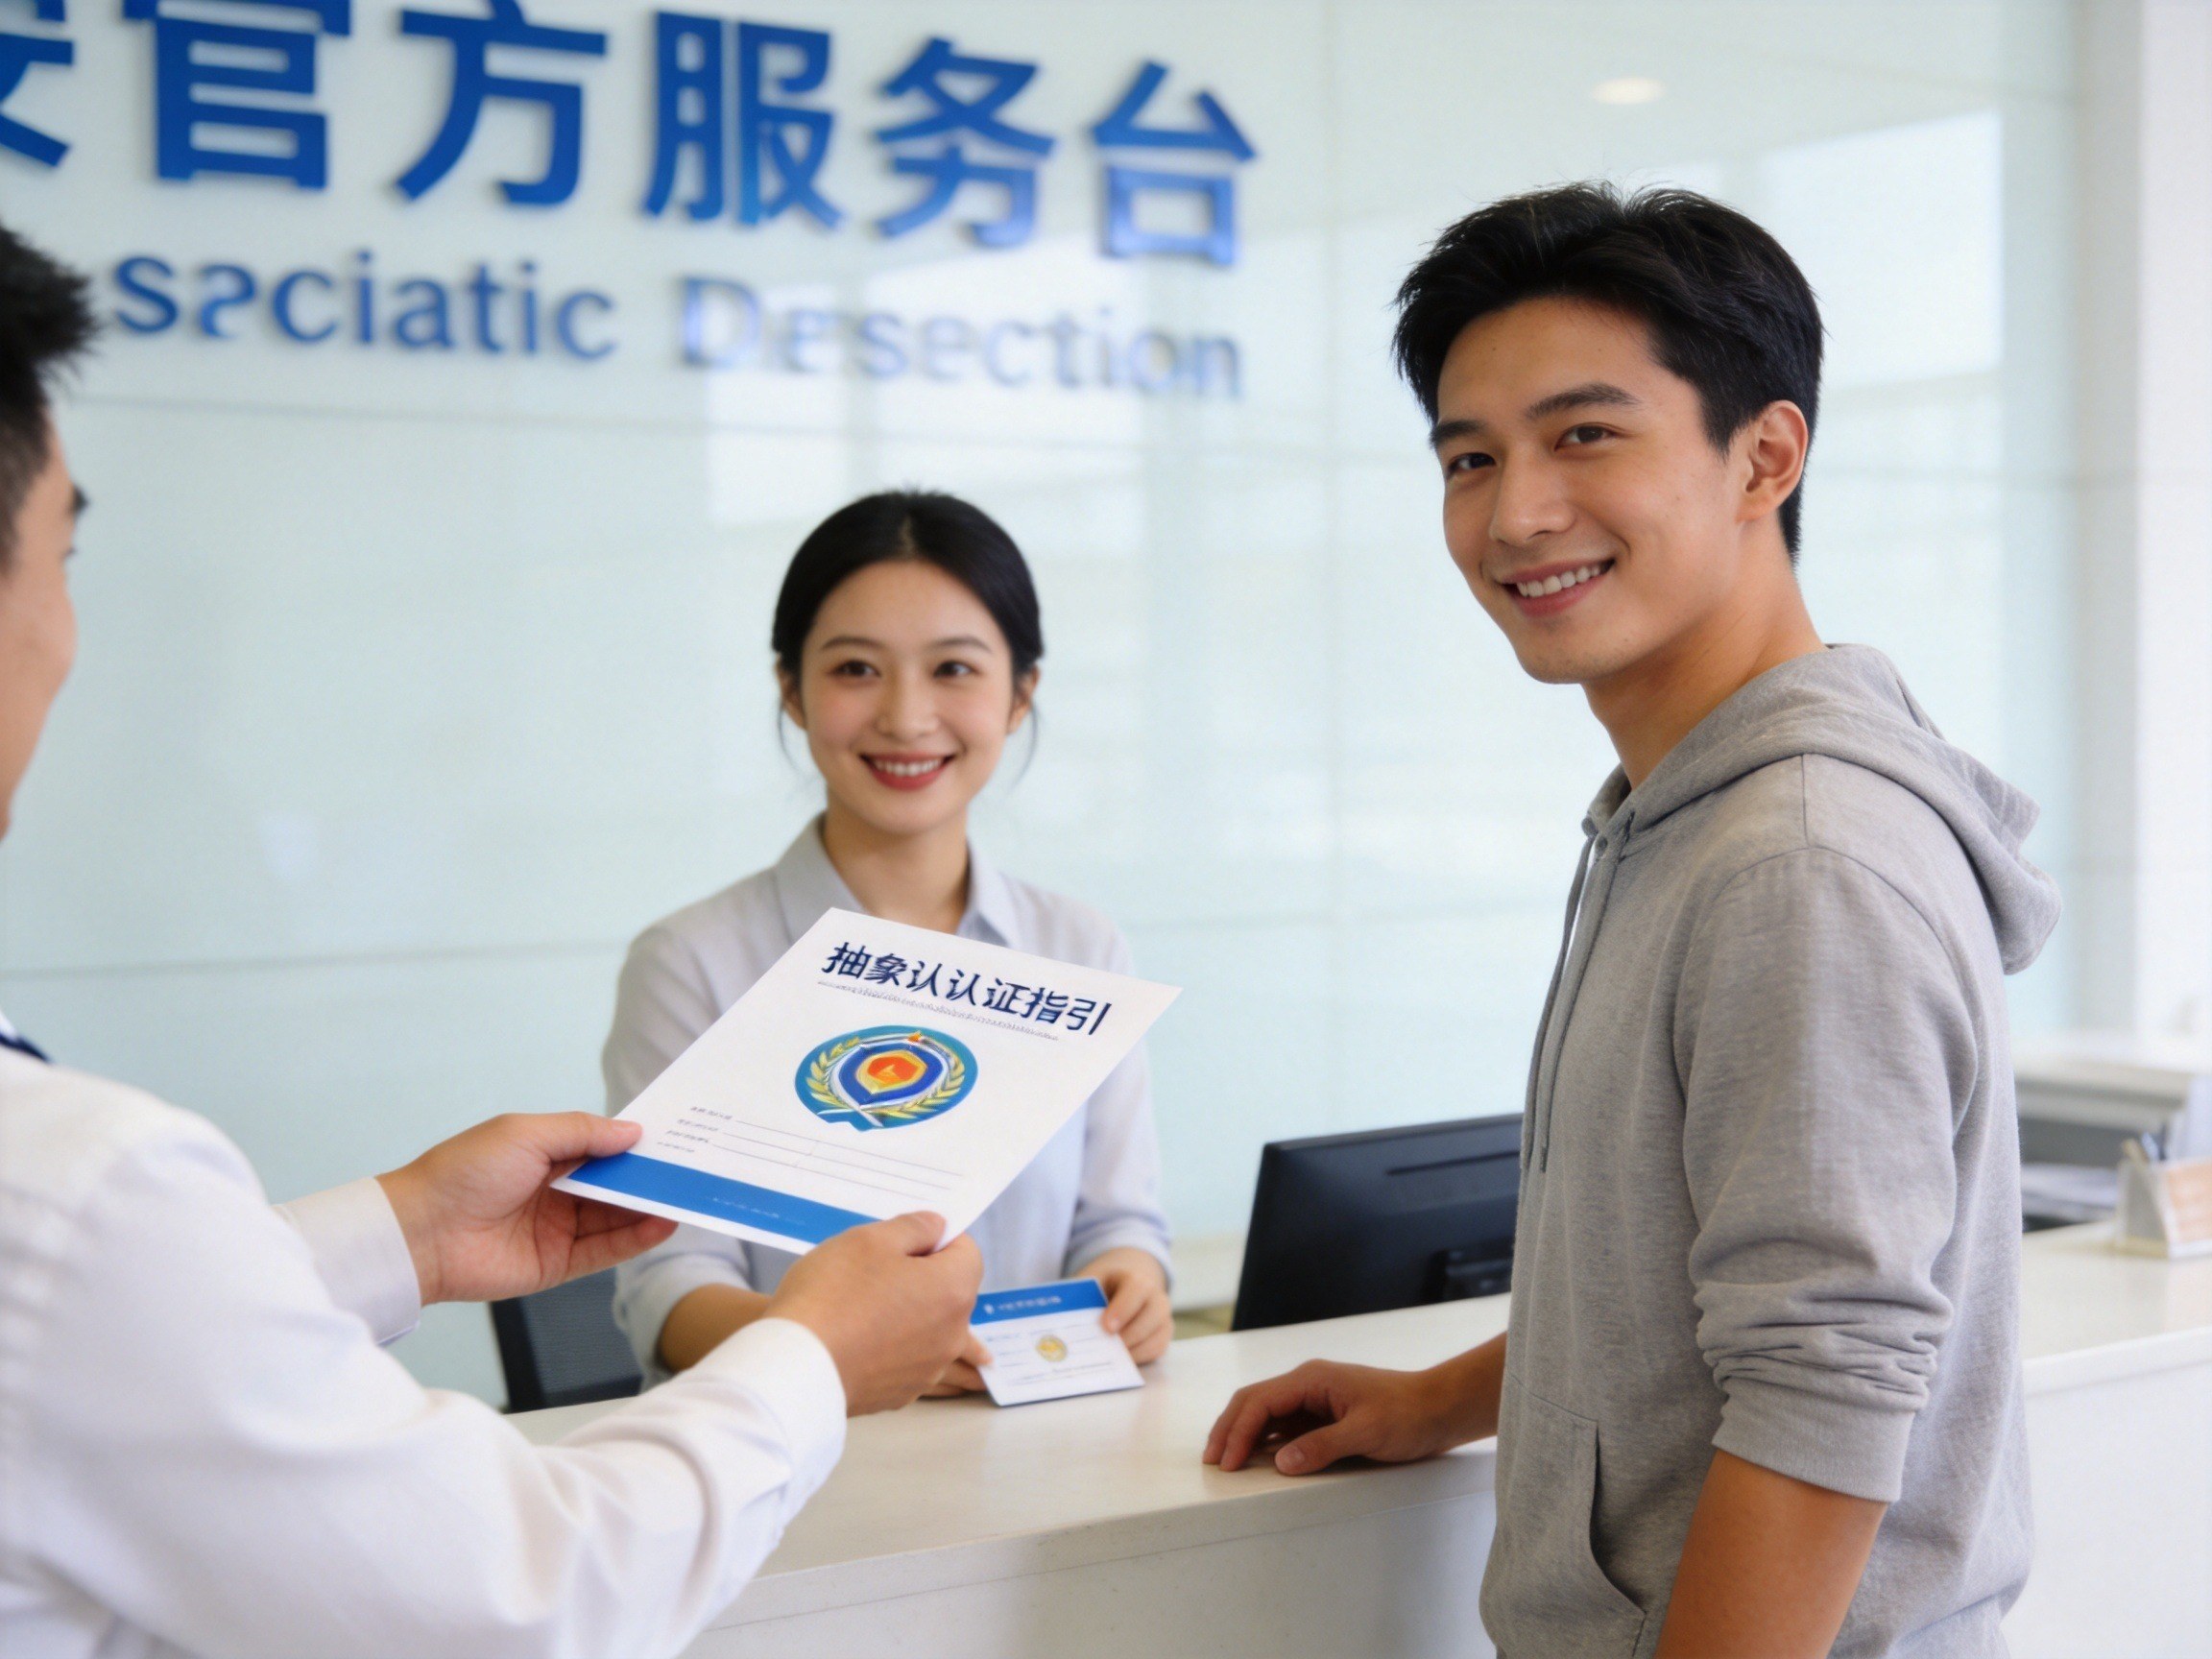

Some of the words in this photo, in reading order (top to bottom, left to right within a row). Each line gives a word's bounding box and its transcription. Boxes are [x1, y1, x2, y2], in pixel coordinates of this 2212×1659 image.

[821, 941, 1113, 1036] 抽象认认证指引
